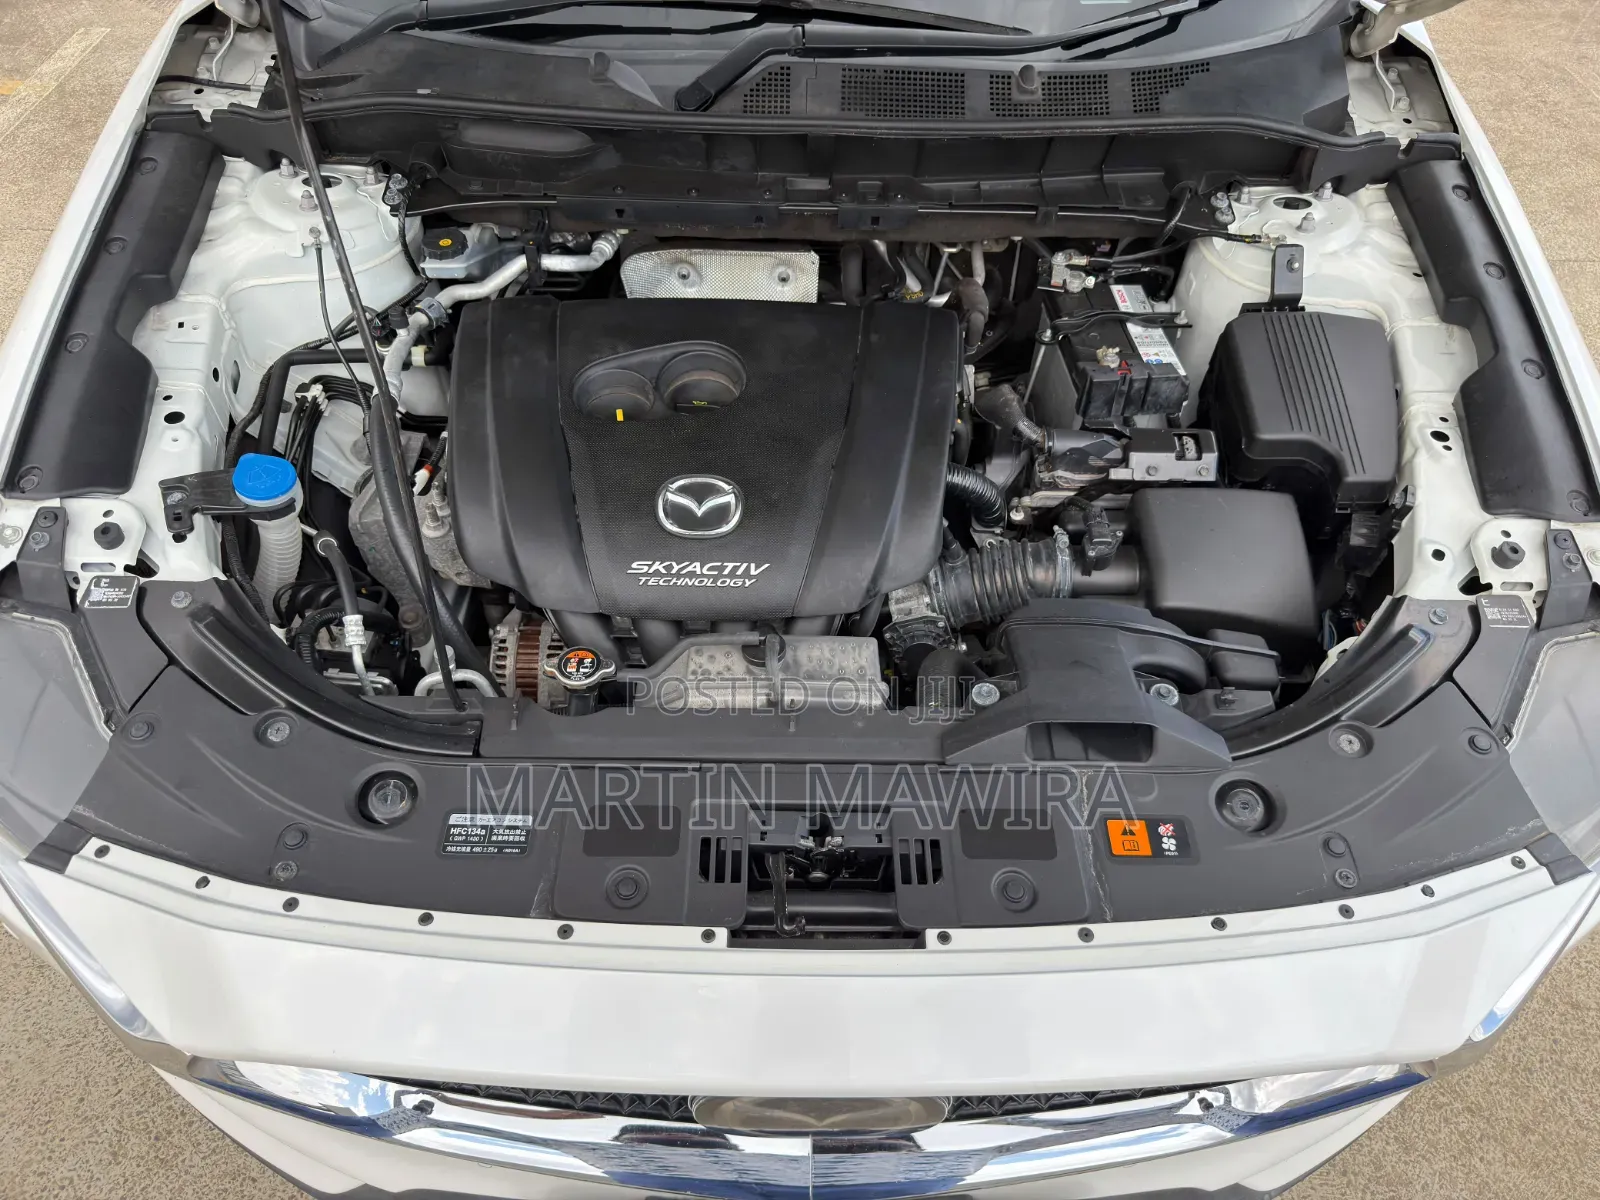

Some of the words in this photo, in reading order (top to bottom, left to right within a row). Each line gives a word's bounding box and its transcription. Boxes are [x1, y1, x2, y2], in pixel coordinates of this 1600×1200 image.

[626, 560, 771, 576] SKYACTIV
[638, 576, 757, 588] TECHNOLOGY
[450, 827, 486, 835] HFC134a
